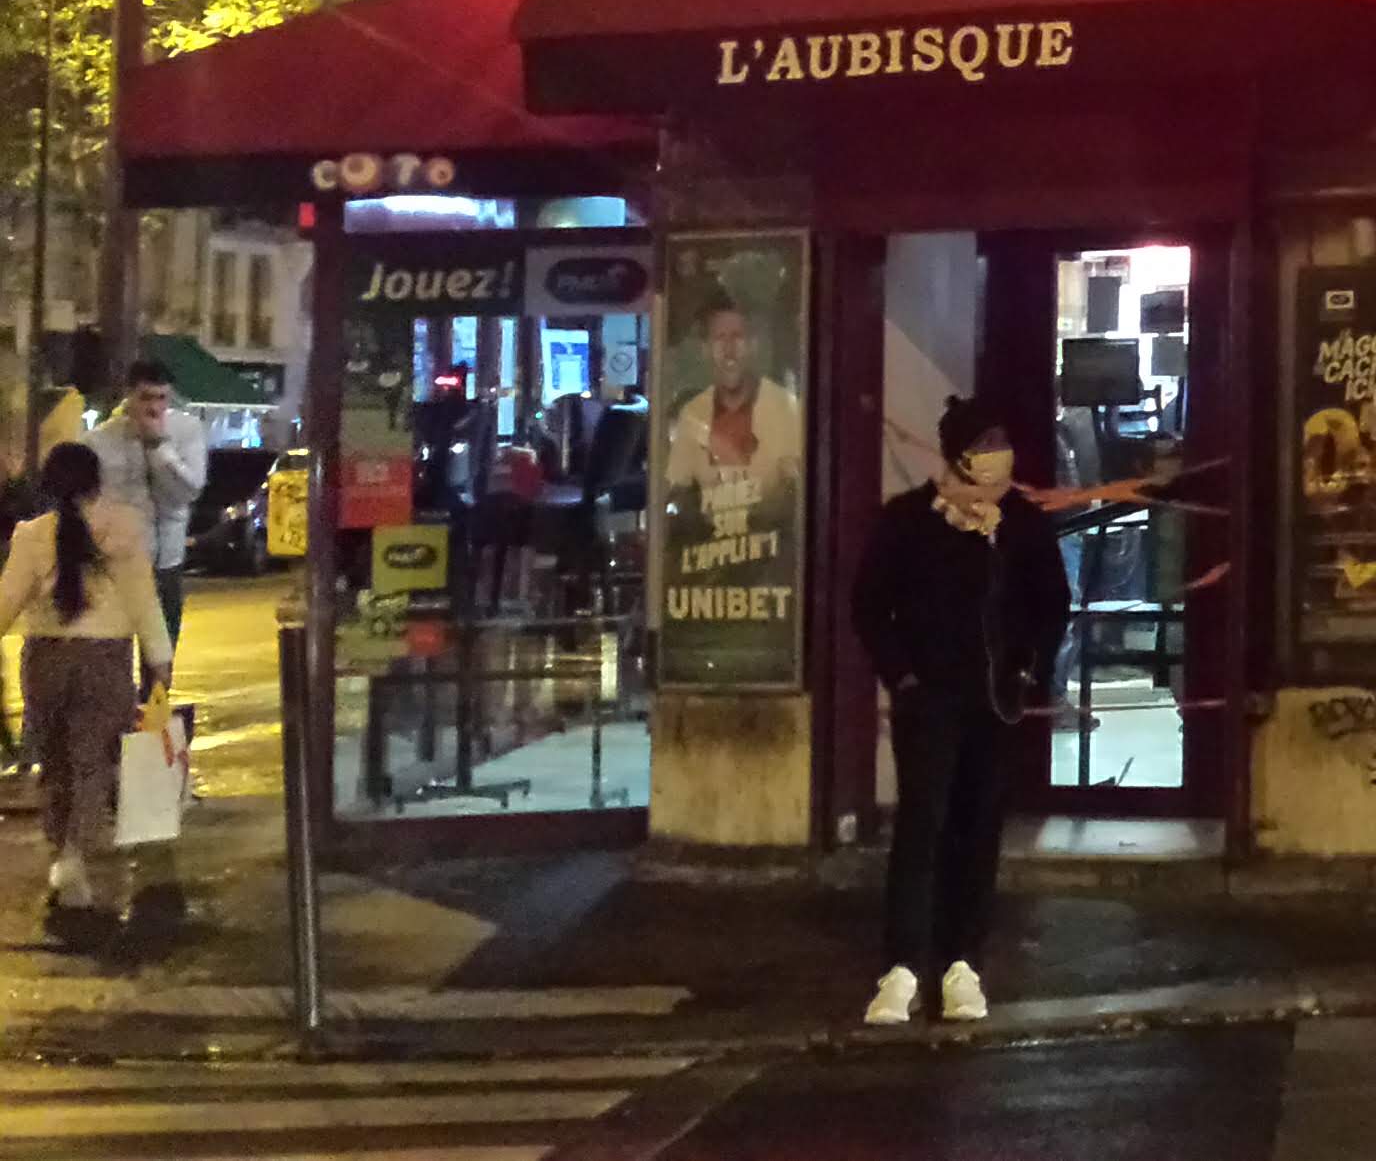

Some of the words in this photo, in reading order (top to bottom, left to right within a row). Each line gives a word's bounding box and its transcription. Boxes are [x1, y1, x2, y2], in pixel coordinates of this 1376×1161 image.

[717, 20, 1074, 85] L'AUBISQUE
[360, 261, 515, 301] Jouez!
[667, 585, 793, 619] UNIBET
